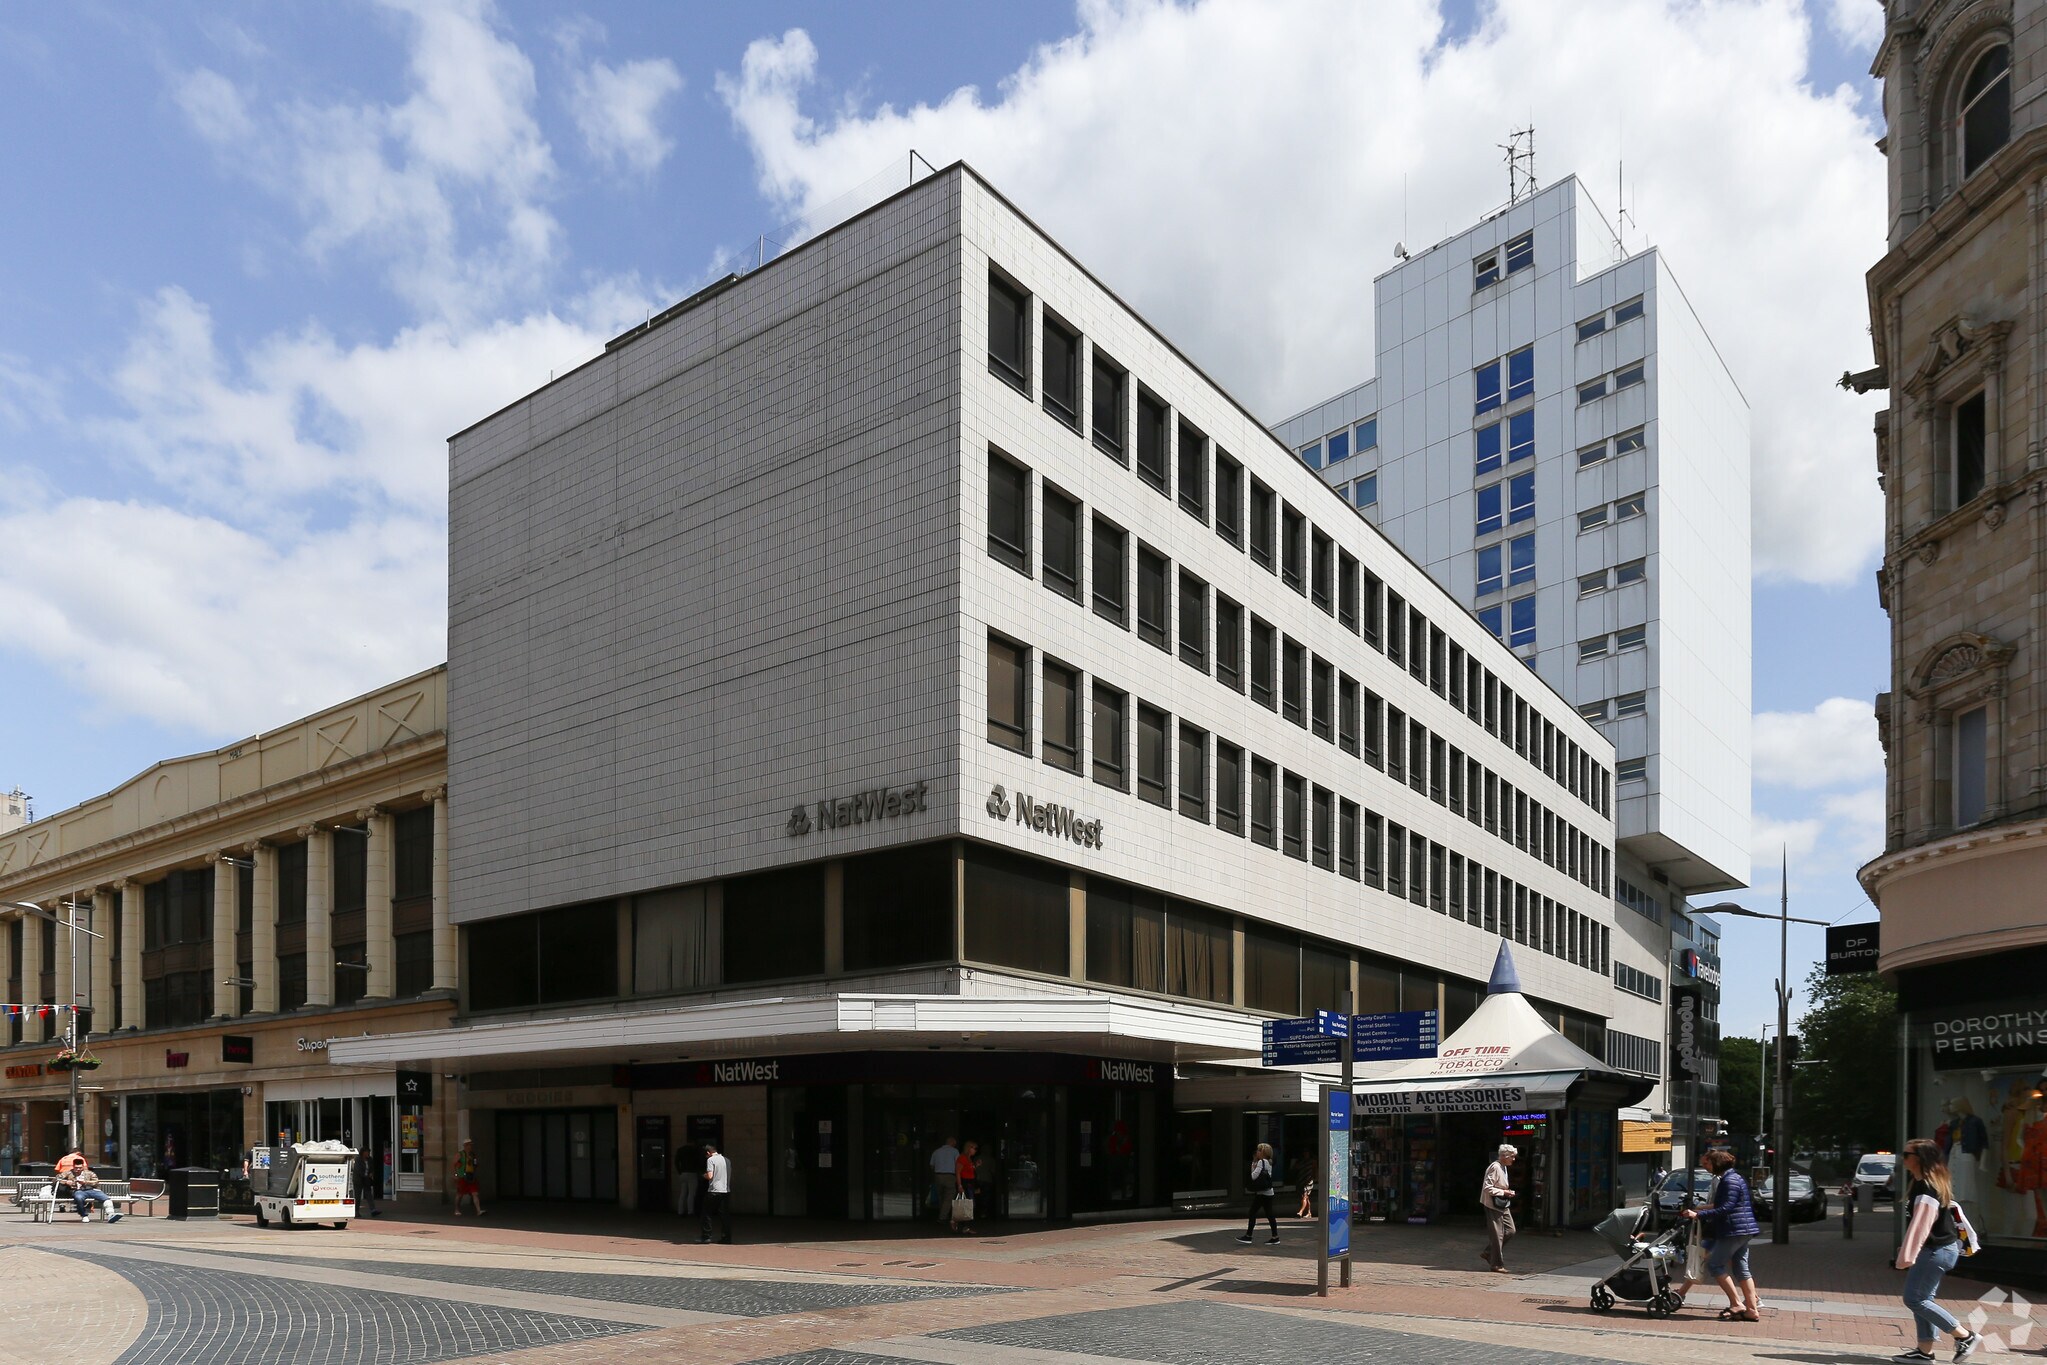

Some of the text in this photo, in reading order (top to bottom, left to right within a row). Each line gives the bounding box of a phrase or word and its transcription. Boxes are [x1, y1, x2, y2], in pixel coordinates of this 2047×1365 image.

[817, 780, 928, 832] NatWest
[1016, 791, 1104, 851] NatWest
[1845, 937, 1868, 948] DP
[1695, 955, 1721, 991] Travelodge
[1933, 1010, 2047, 1036] DOROTHY
[1442, 1046, 1511, 1057] OFF TIME
[714, 1060, 779, 1082] NatWest
[1101, 1060, 1154, 1083] NatWest
[1438, 1059, 1504, 1070] TOBACCO
[1356, 1092, 1412, 1107] MOBILE
[1416, 1088, 1522, 1105] ACCESSORIES
[1368, 1106, 1412, 1114] REPAIR
[1437, 1103, 1512, 1112] UNLOCKING
